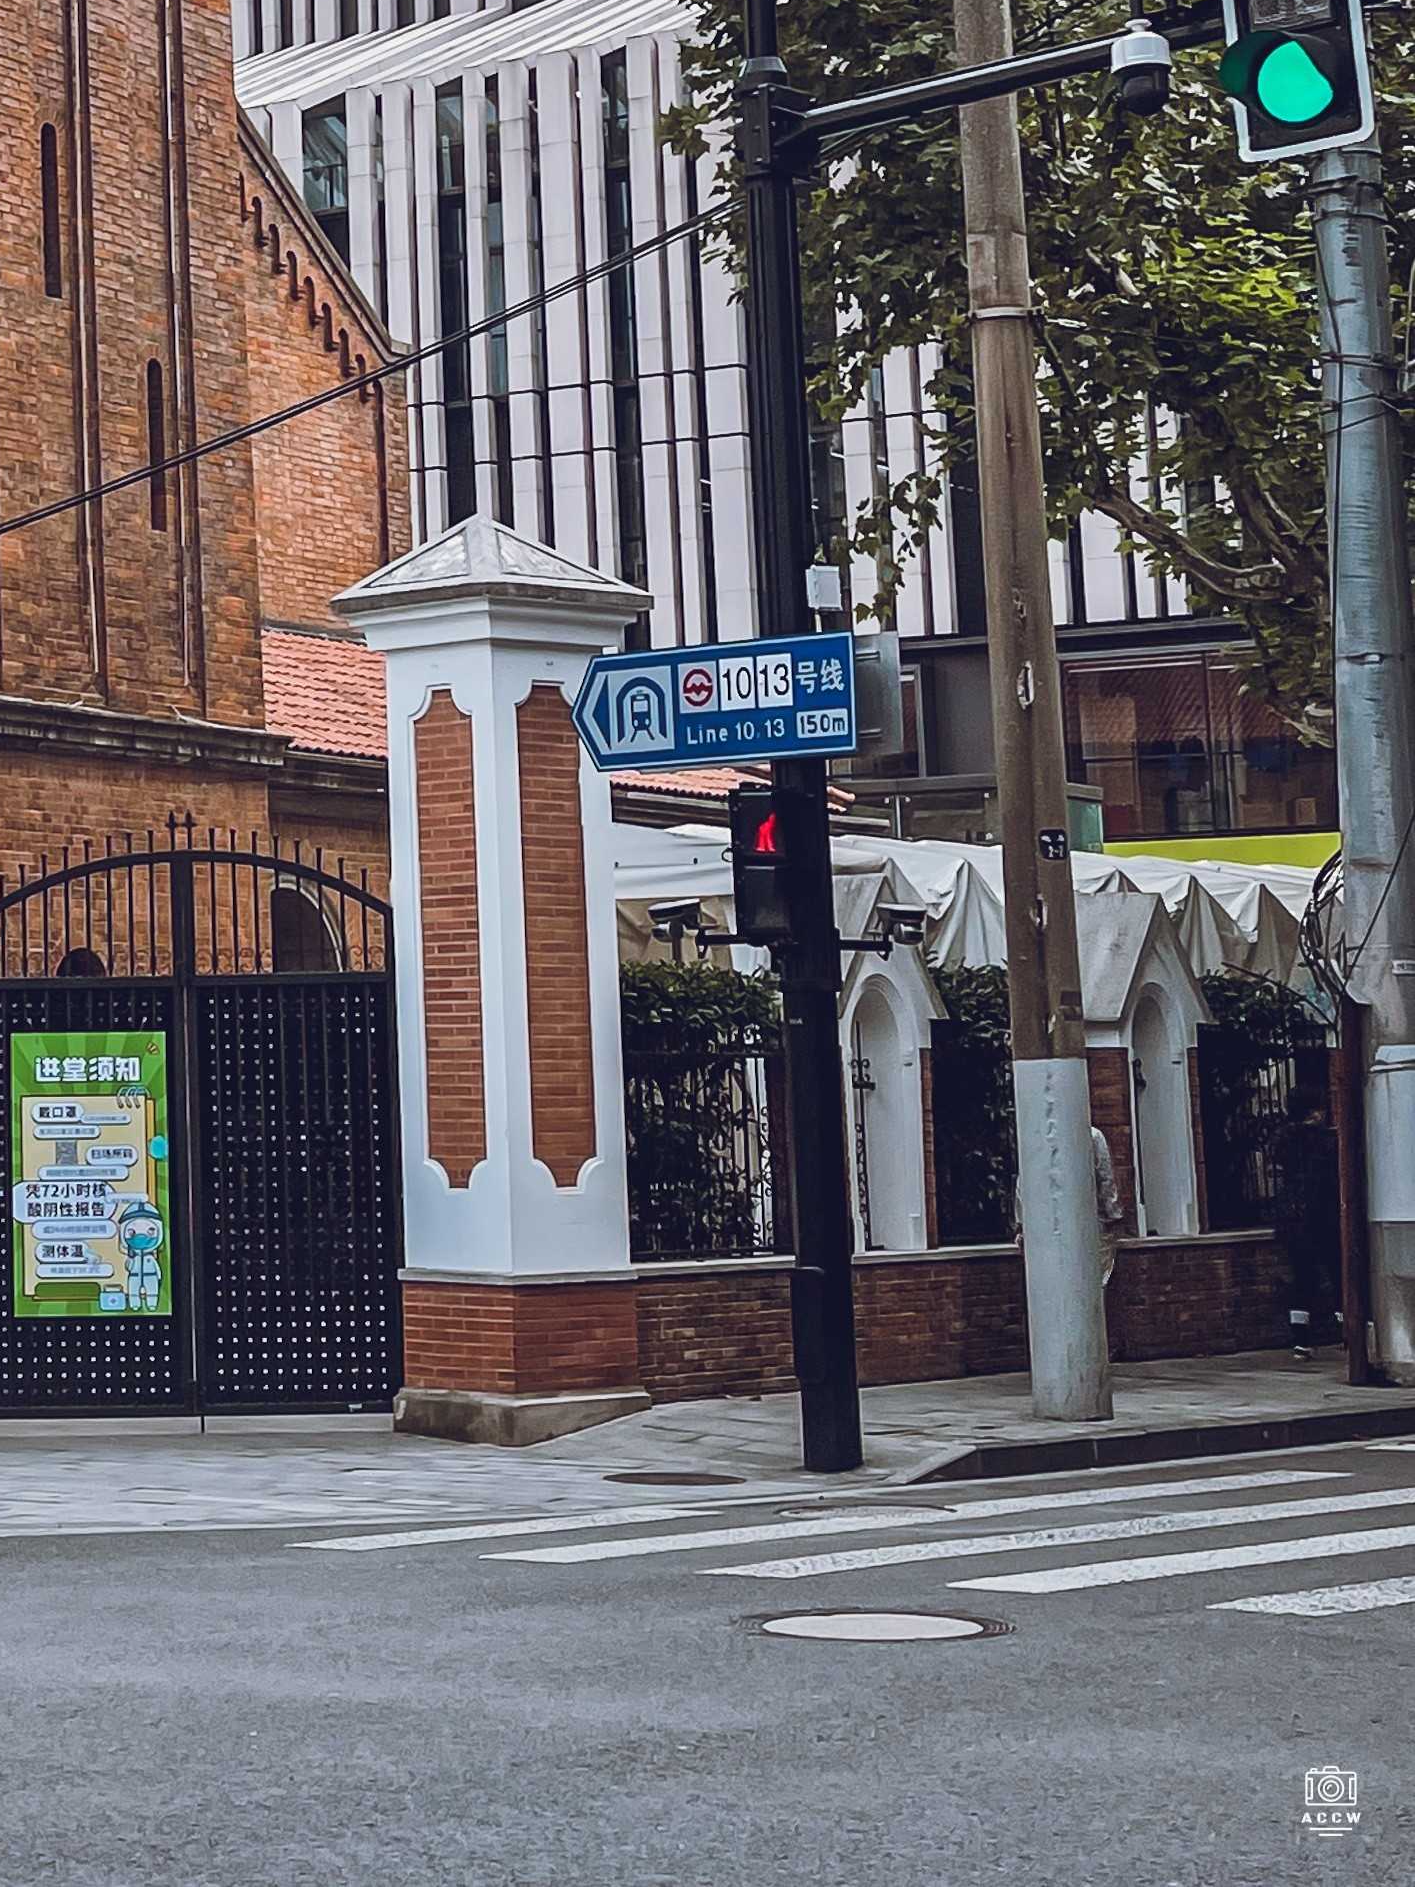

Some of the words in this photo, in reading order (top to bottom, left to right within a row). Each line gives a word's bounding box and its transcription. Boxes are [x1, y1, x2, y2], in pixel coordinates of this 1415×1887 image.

[722, 664, 752, 701] 10
[759, 662, 790, 697] 13
[795, 658, 845, 694] 号线
[800, 713, 847, 734] 150m
[686, 724, 728, 745] Line
[35, 1057, 140, 1083] 进堂须知
[25, 1183, 107, 1199] 凭72小时核
[27, 1202, 105, 1217] 酸阴性报告
[41, 1245, 84, 1258] 测体温
